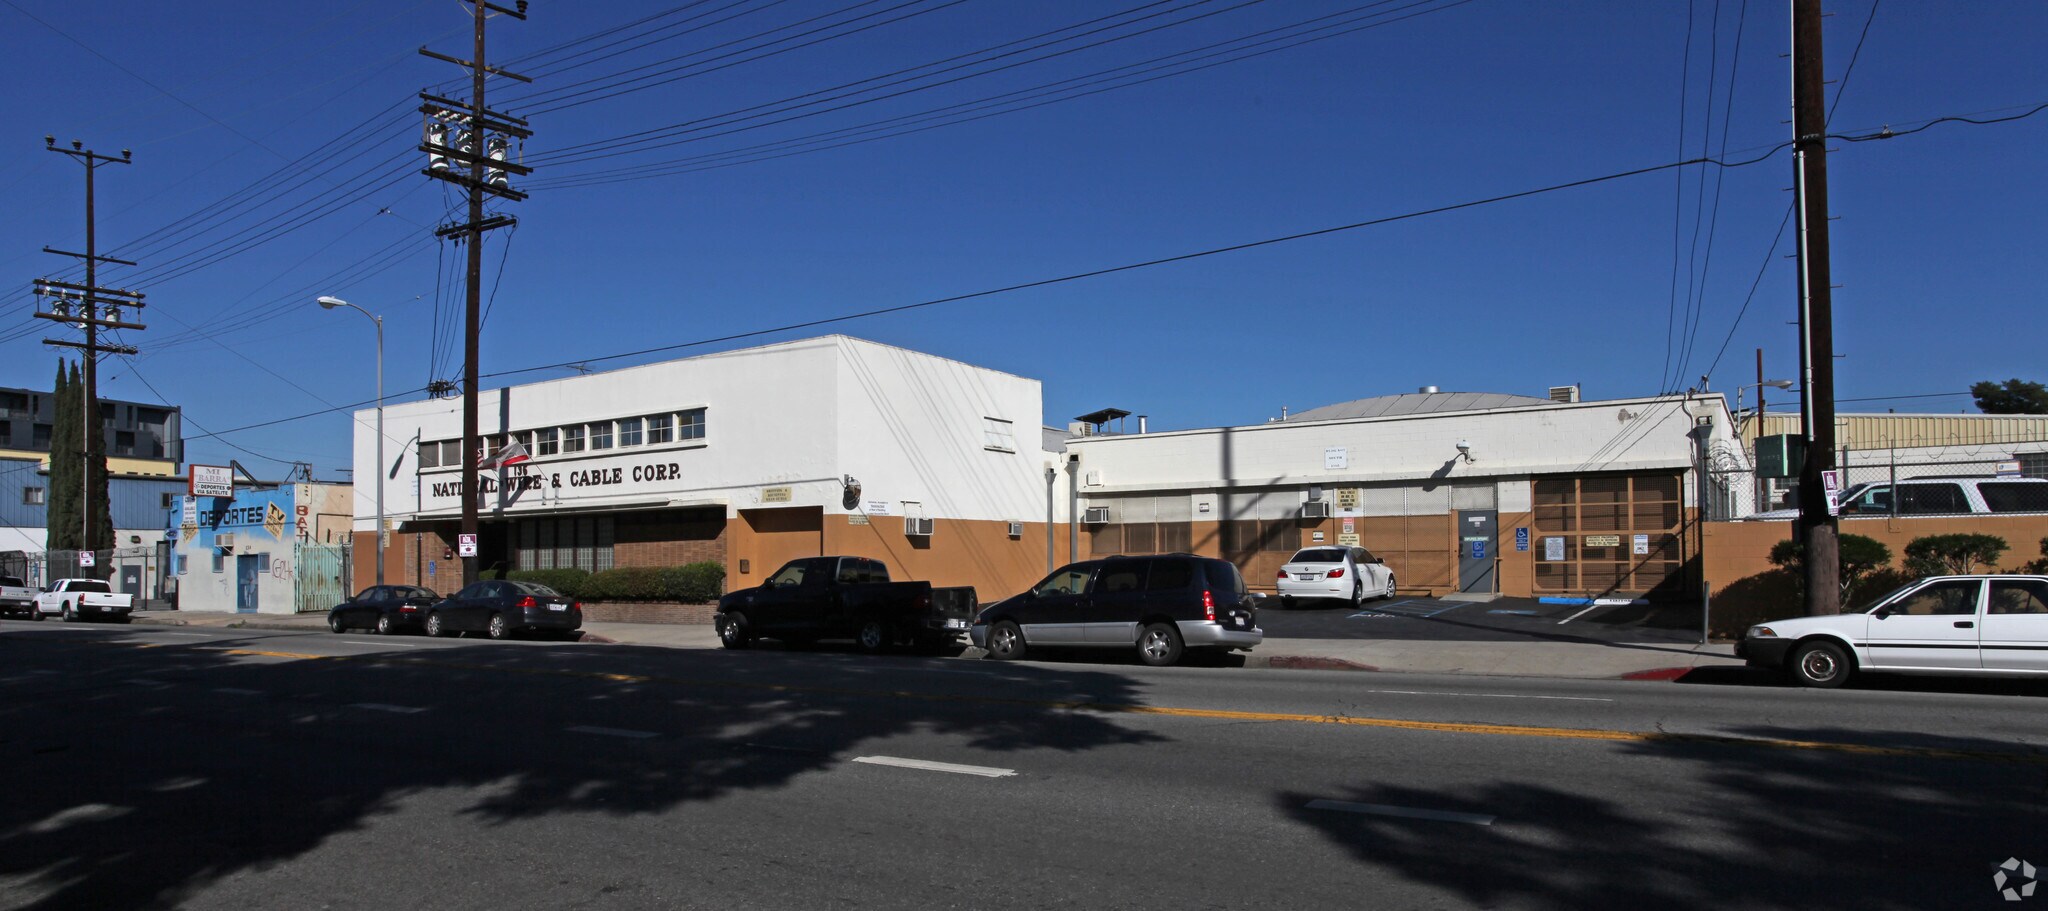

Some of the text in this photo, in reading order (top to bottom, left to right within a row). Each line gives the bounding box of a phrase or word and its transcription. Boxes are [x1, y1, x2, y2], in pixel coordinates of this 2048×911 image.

[432, 462, 681, 497] NATIAL WIRE & CABLE CORP.
[513, 464, 528, 476] 136
[200, 506, 264, 526] DEPORTES
[270, 503, 285, 521] TV
